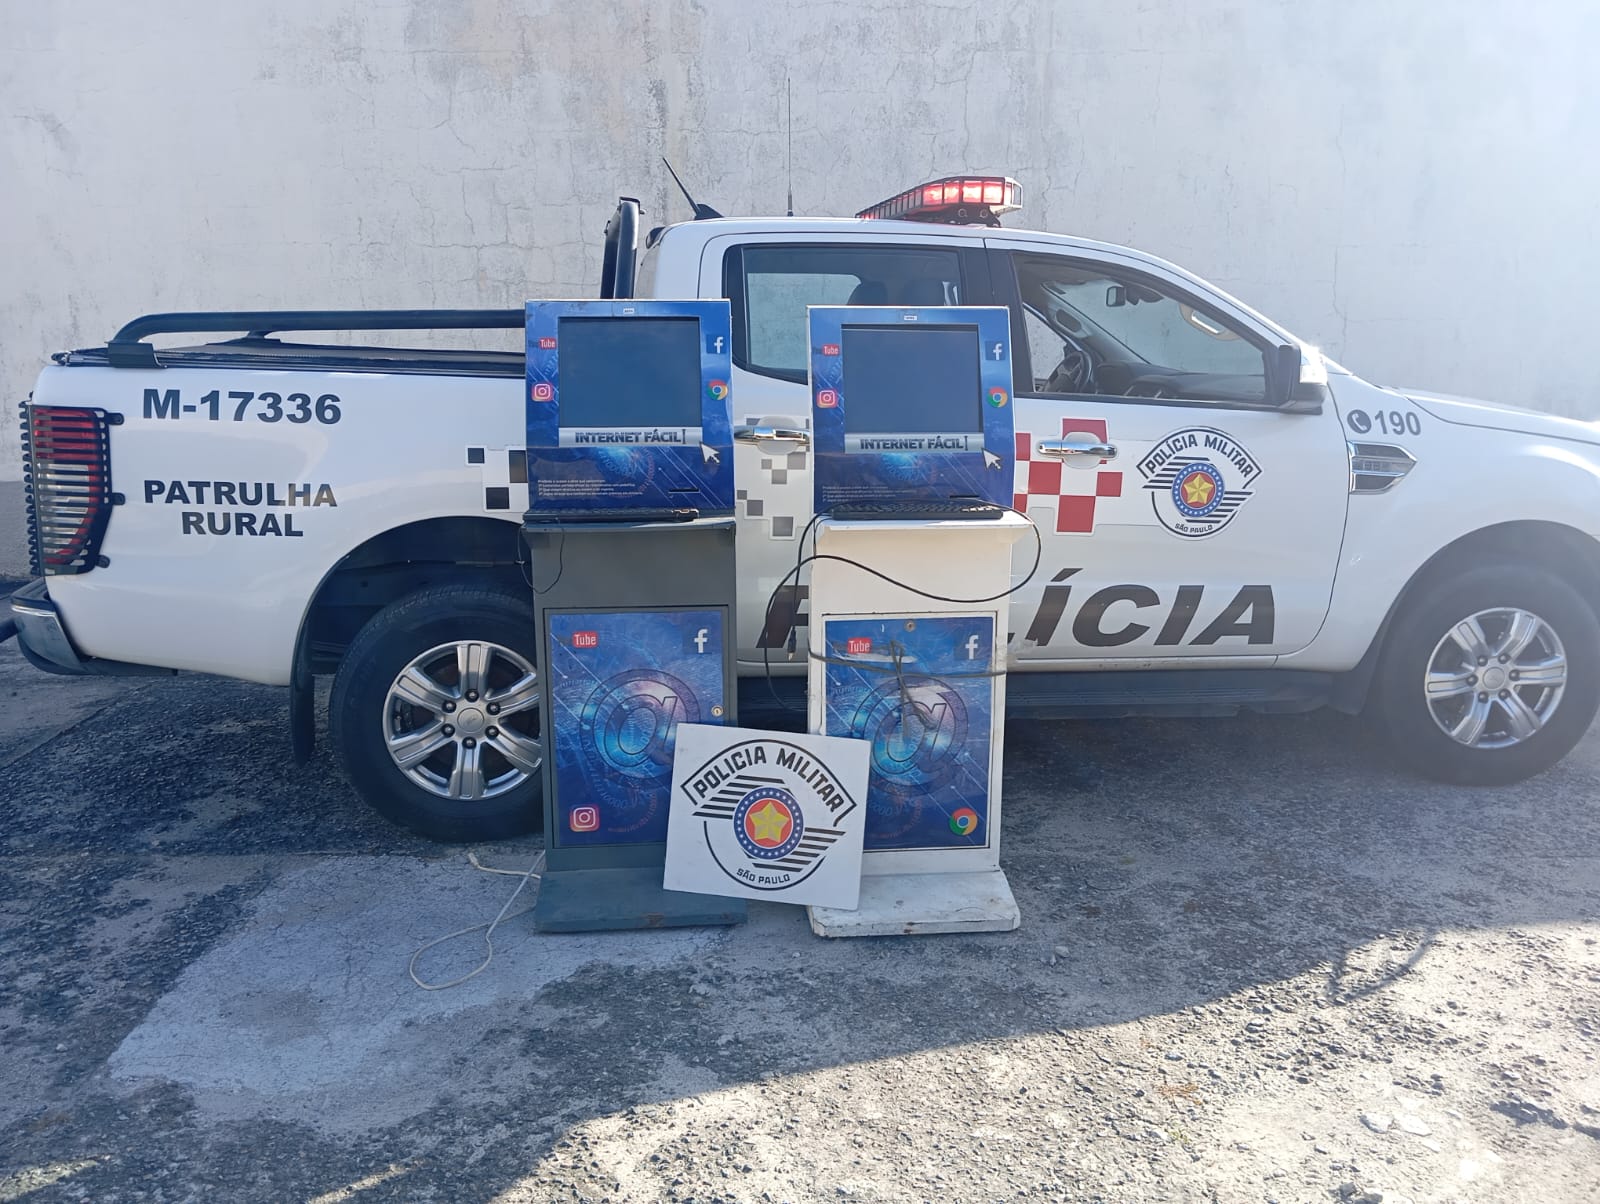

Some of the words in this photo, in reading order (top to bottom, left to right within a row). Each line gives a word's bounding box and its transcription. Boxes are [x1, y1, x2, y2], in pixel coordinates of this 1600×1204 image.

[143, 388, 341, 424] M-17336
[575, 431, 642, 443] INTERNET
[644, 429, 681, 443] FÁCIL
[1374, 410, 1421, 436] 190
[860, 438, 925, 449] INTERNET
[927, 435, 964, 449] FÁCIL
[1144, 433, 1198, 475] POLÍCIA
[1204, 434, 1254, 478] MILITAR
[144, 480, 338, 507] PATRULHA
[181, 511, 304, 537] RURAL
[1174, 522, 1189, 533] SÃO
[1189, 523, 1214, 534] PAULO
[756, 567, 1275, 648] PÍCIA
[692, 745, 767, 799] POLICIA
[775, 747, 845, 813] MILITAR
[736, 867, 755, 882] SÃO
[758, 872, 791, 885] PAULO
